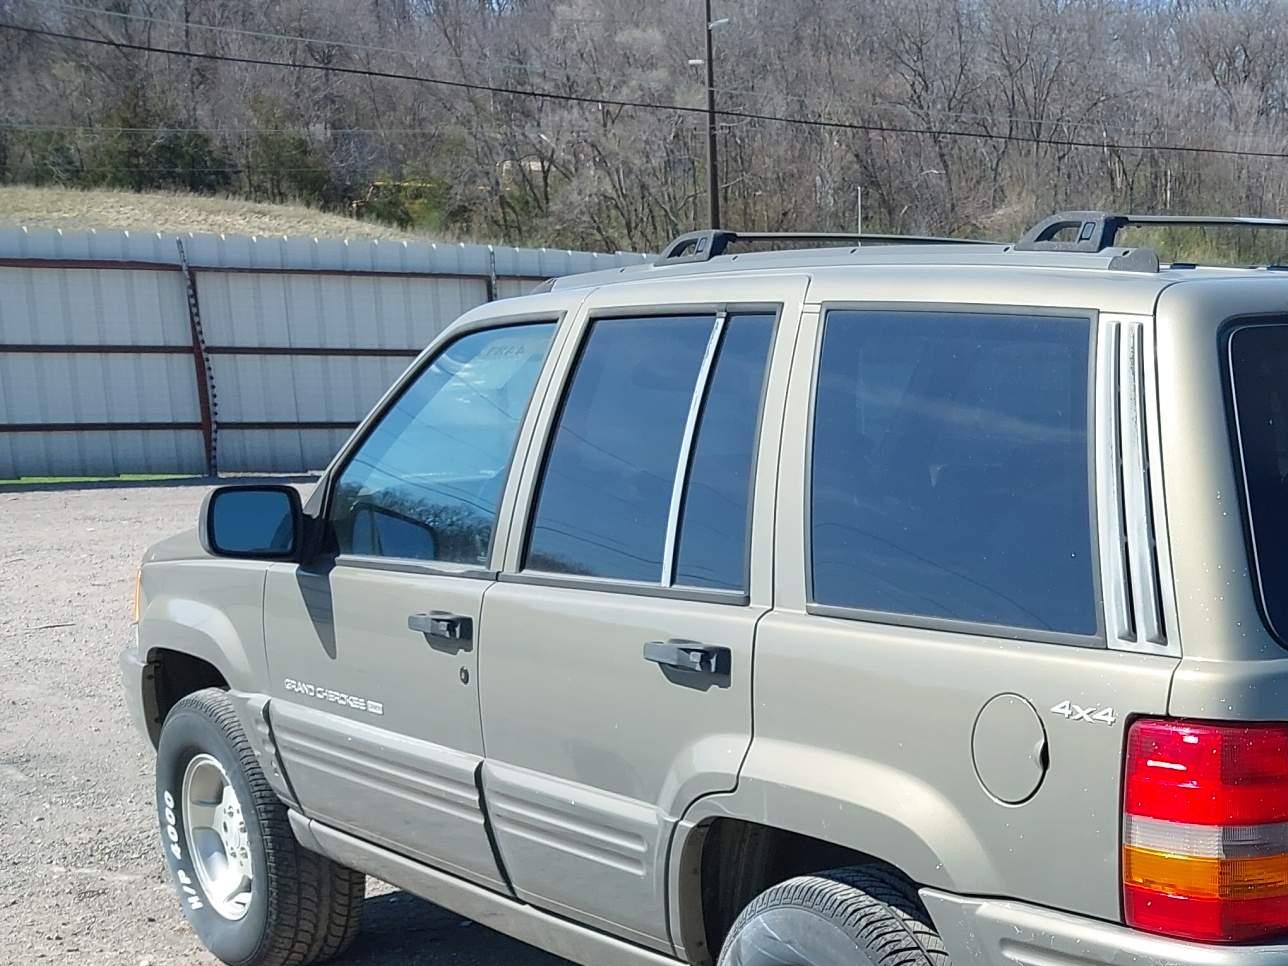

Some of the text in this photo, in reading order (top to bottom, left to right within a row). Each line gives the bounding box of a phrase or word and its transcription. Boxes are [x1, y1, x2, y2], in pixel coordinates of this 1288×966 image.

[284, 678, 315, 697] GRAND
[316, 686, 367, 710] CHEROKEE
[163, 790, 182, 860] 4000
